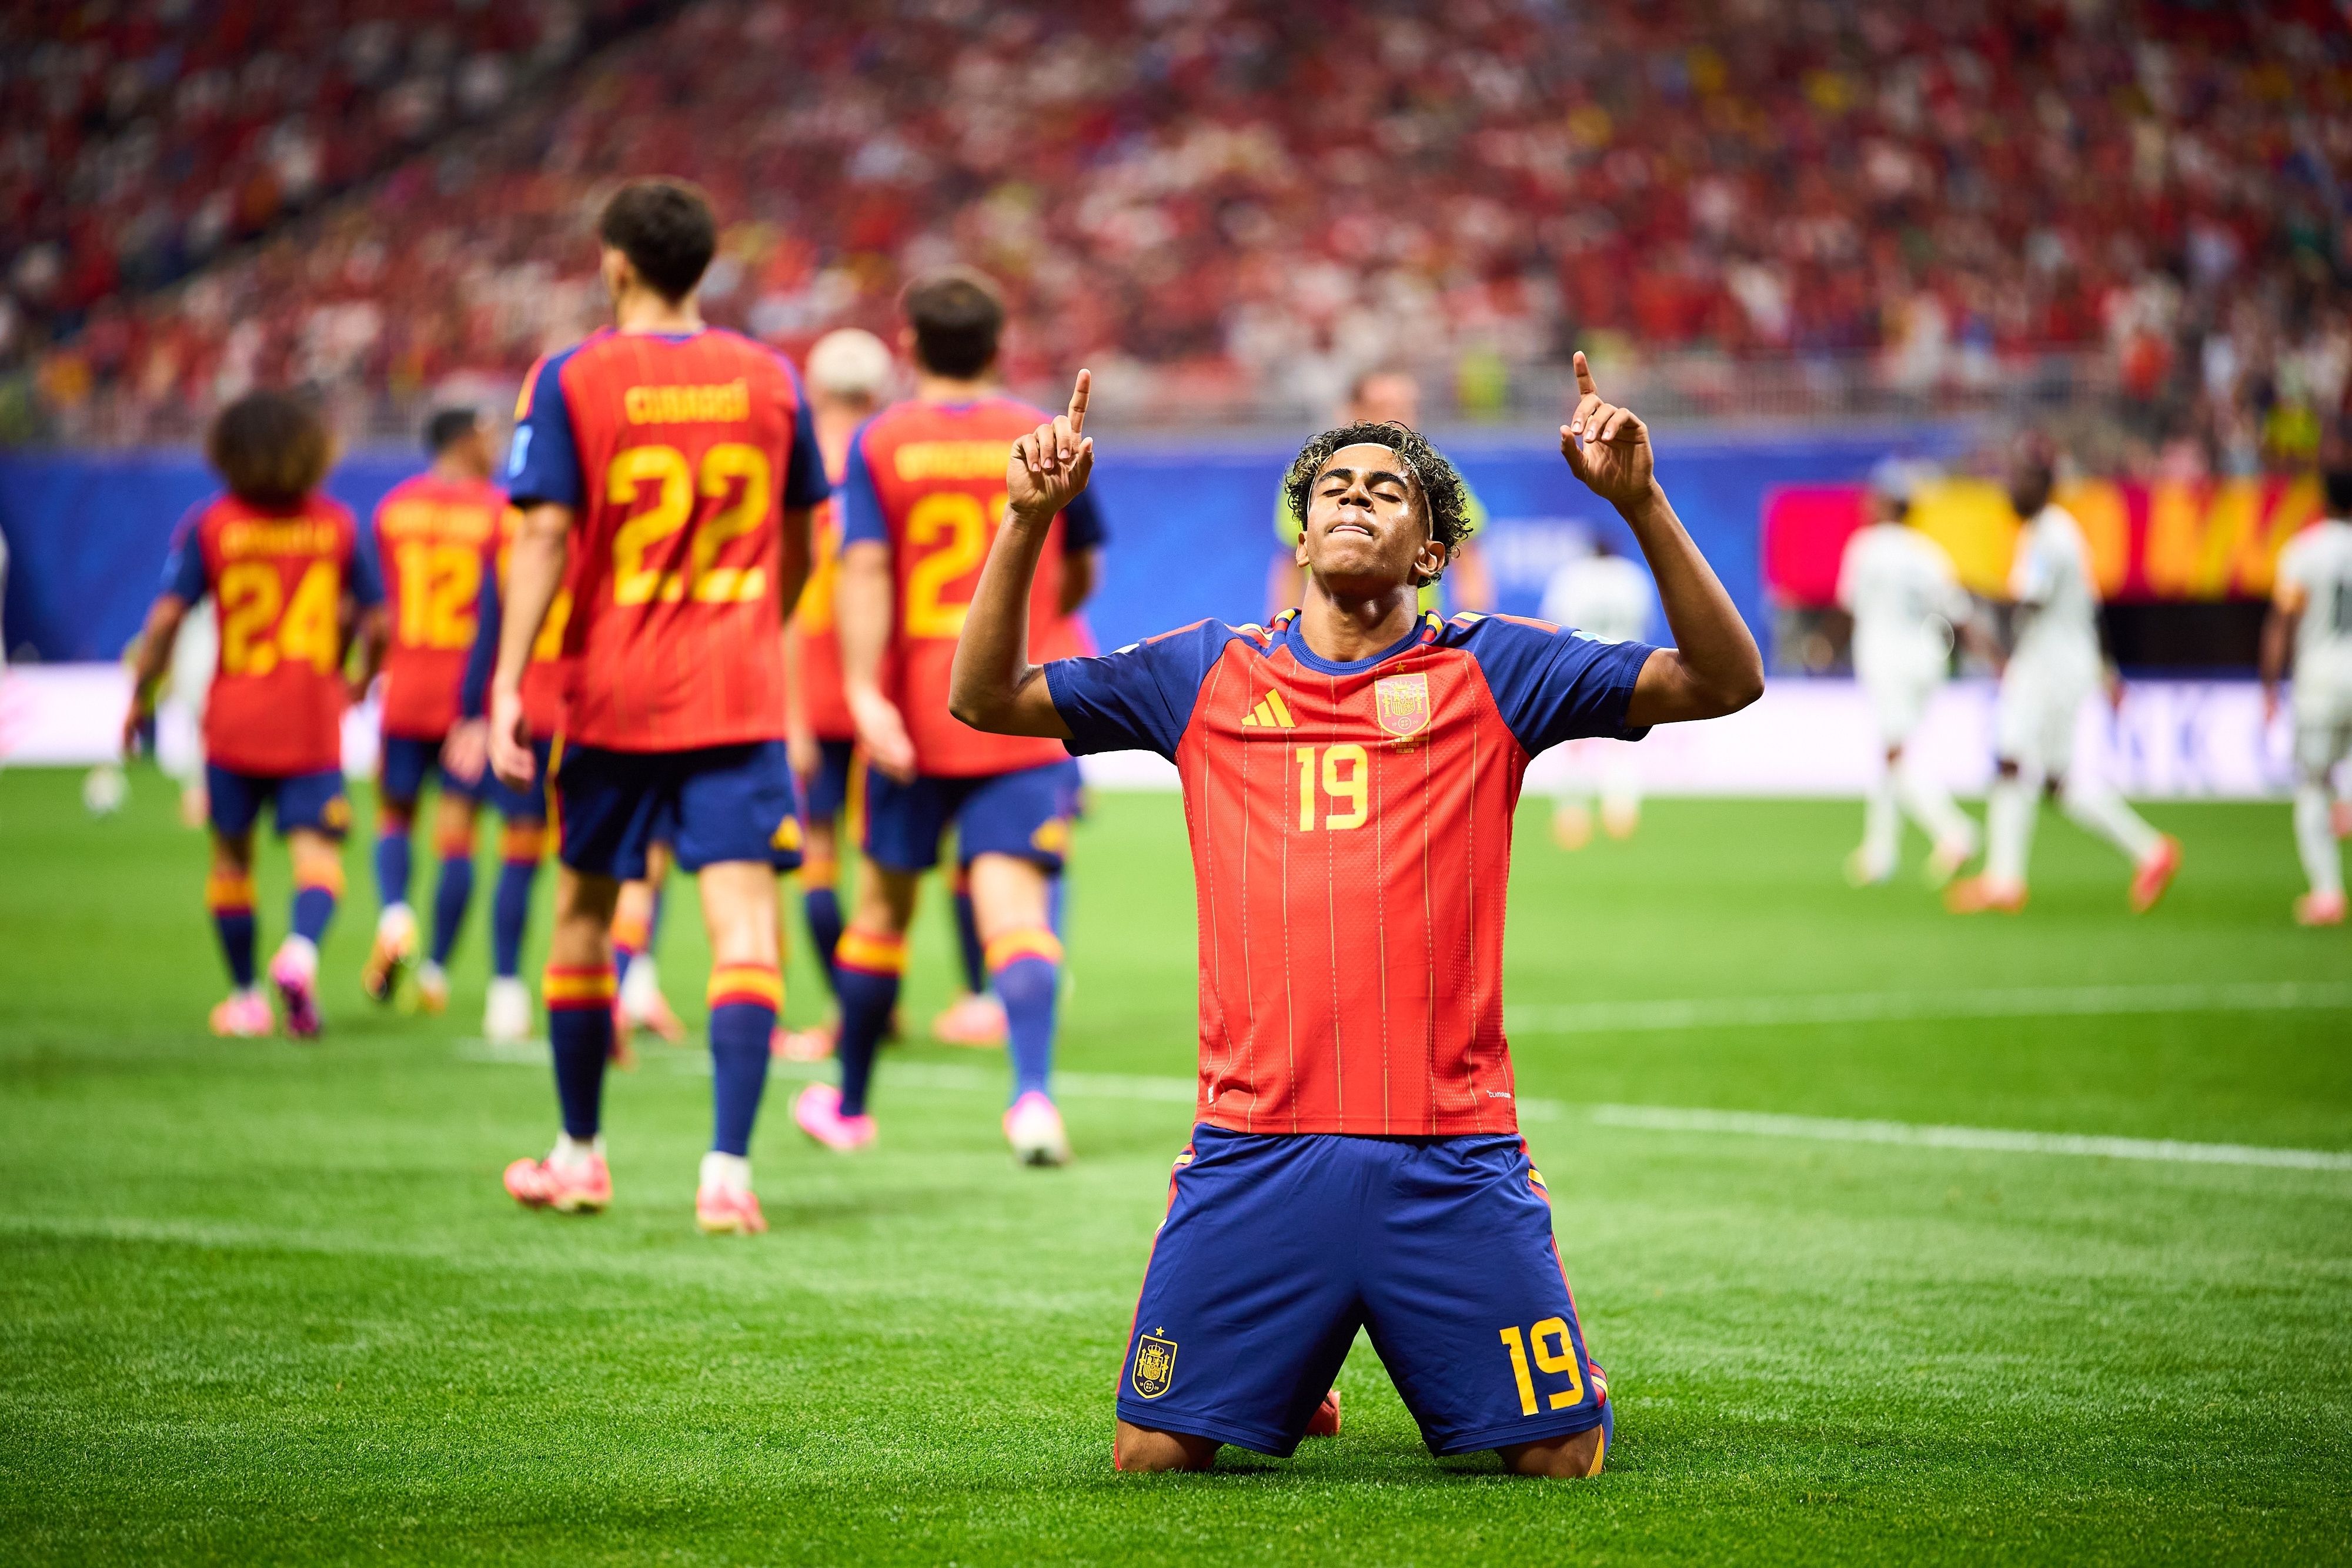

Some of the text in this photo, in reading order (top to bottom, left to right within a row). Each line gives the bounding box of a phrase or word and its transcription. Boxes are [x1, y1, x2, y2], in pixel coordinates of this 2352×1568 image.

[606, 444, 770, 606] 22
[906, 493, 1009, 638] 2
[219, 560, 340, 676] 24
[395, 542, 479, 648] 12
[1296, 744, 1368, 832] 19
[1499, 1317, 1583, 1416] 19
